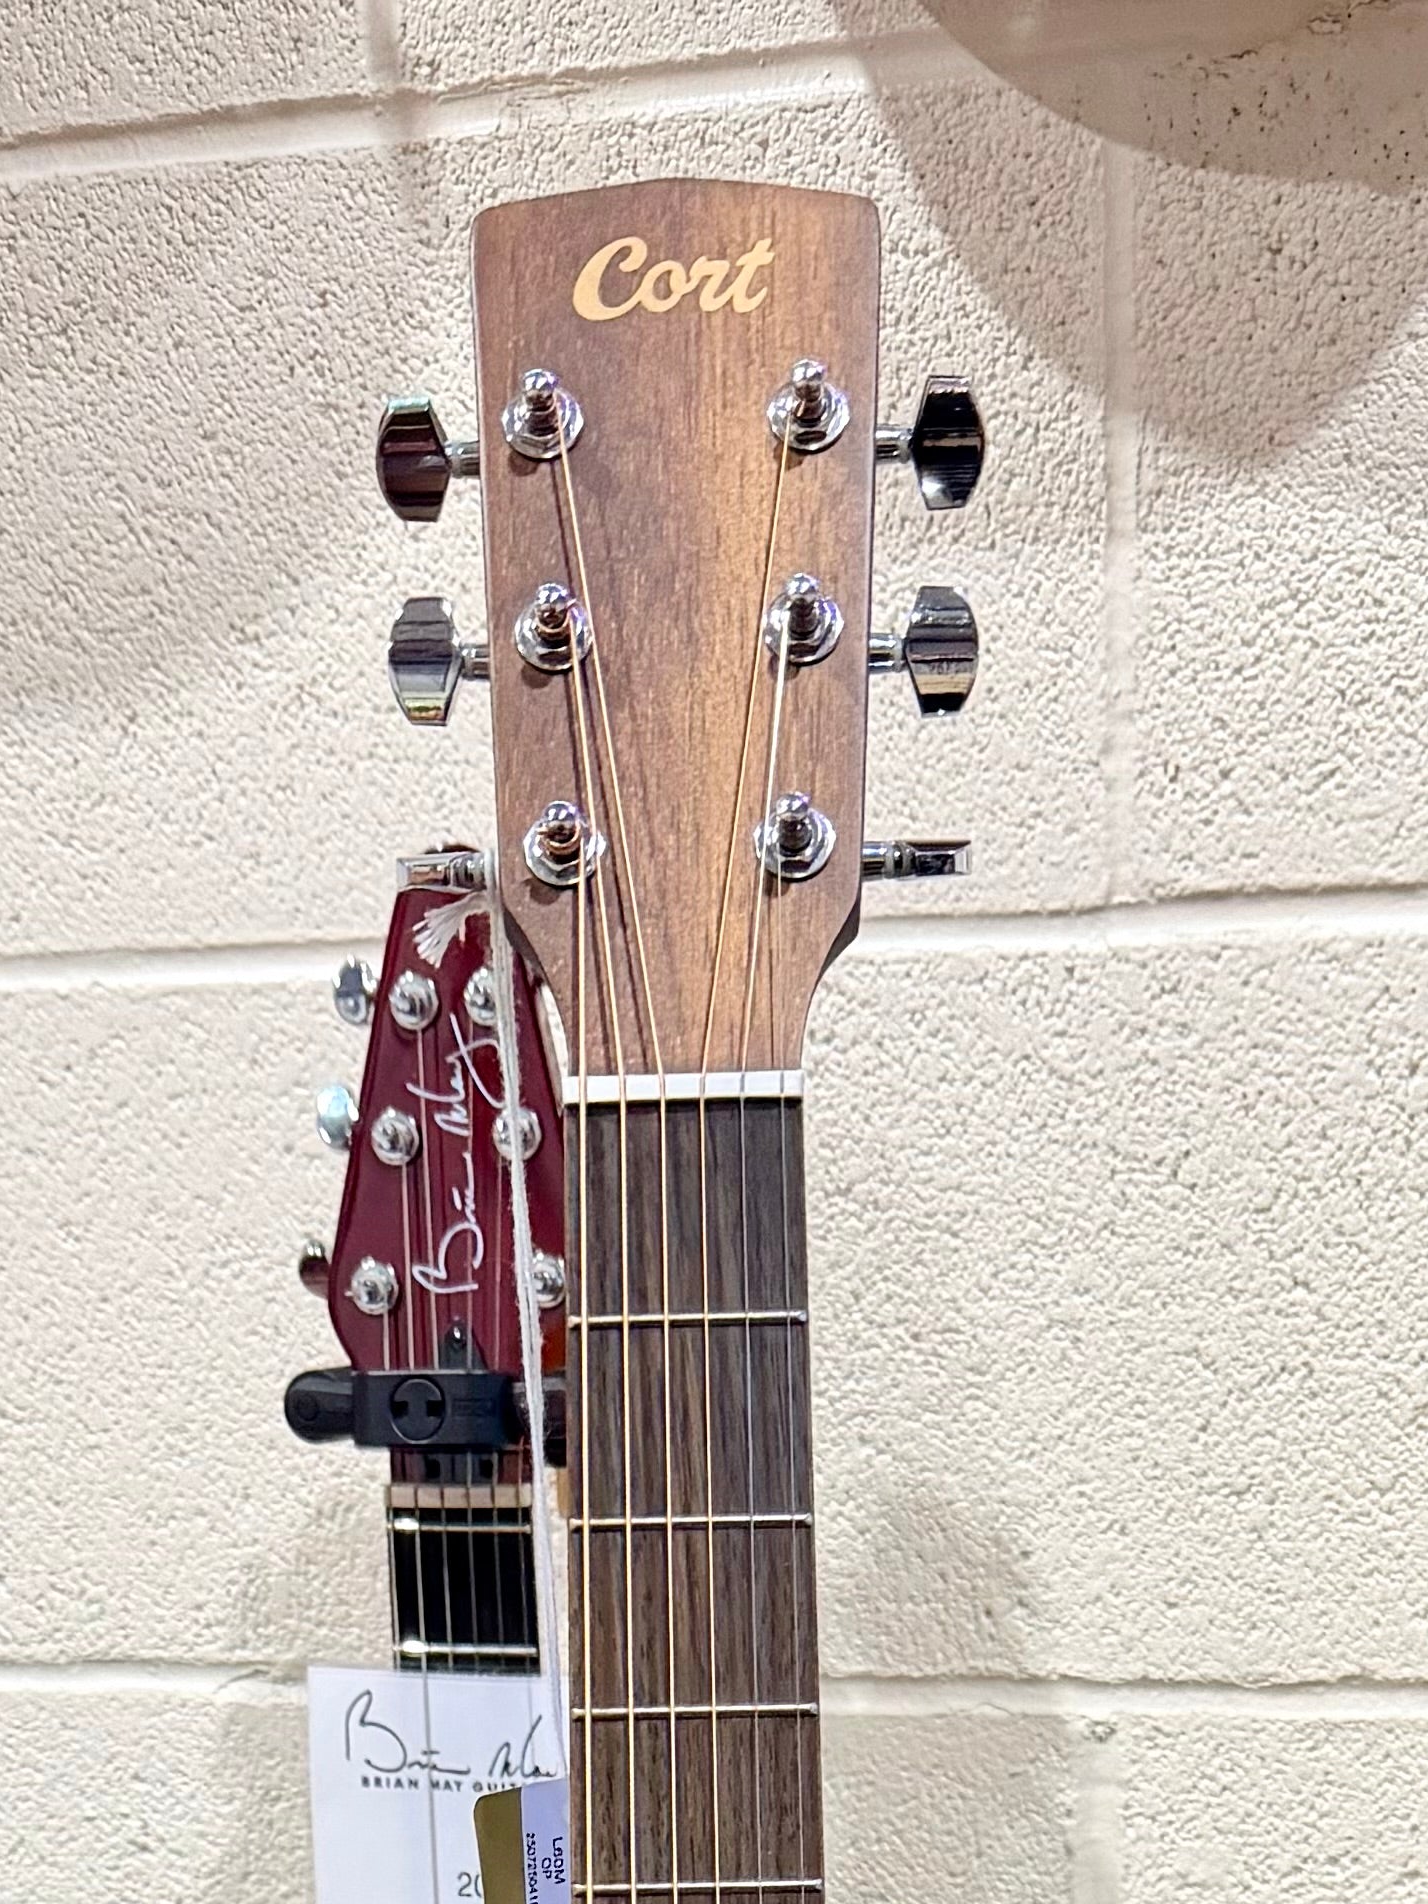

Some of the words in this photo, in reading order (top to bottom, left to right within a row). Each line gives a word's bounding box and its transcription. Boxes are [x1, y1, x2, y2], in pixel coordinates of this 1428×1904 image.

[573, 236, 775, 321] Cort
[361, 1776, 419, 1790] BRIAN
[430, 1780, 463, 1793] MAY
